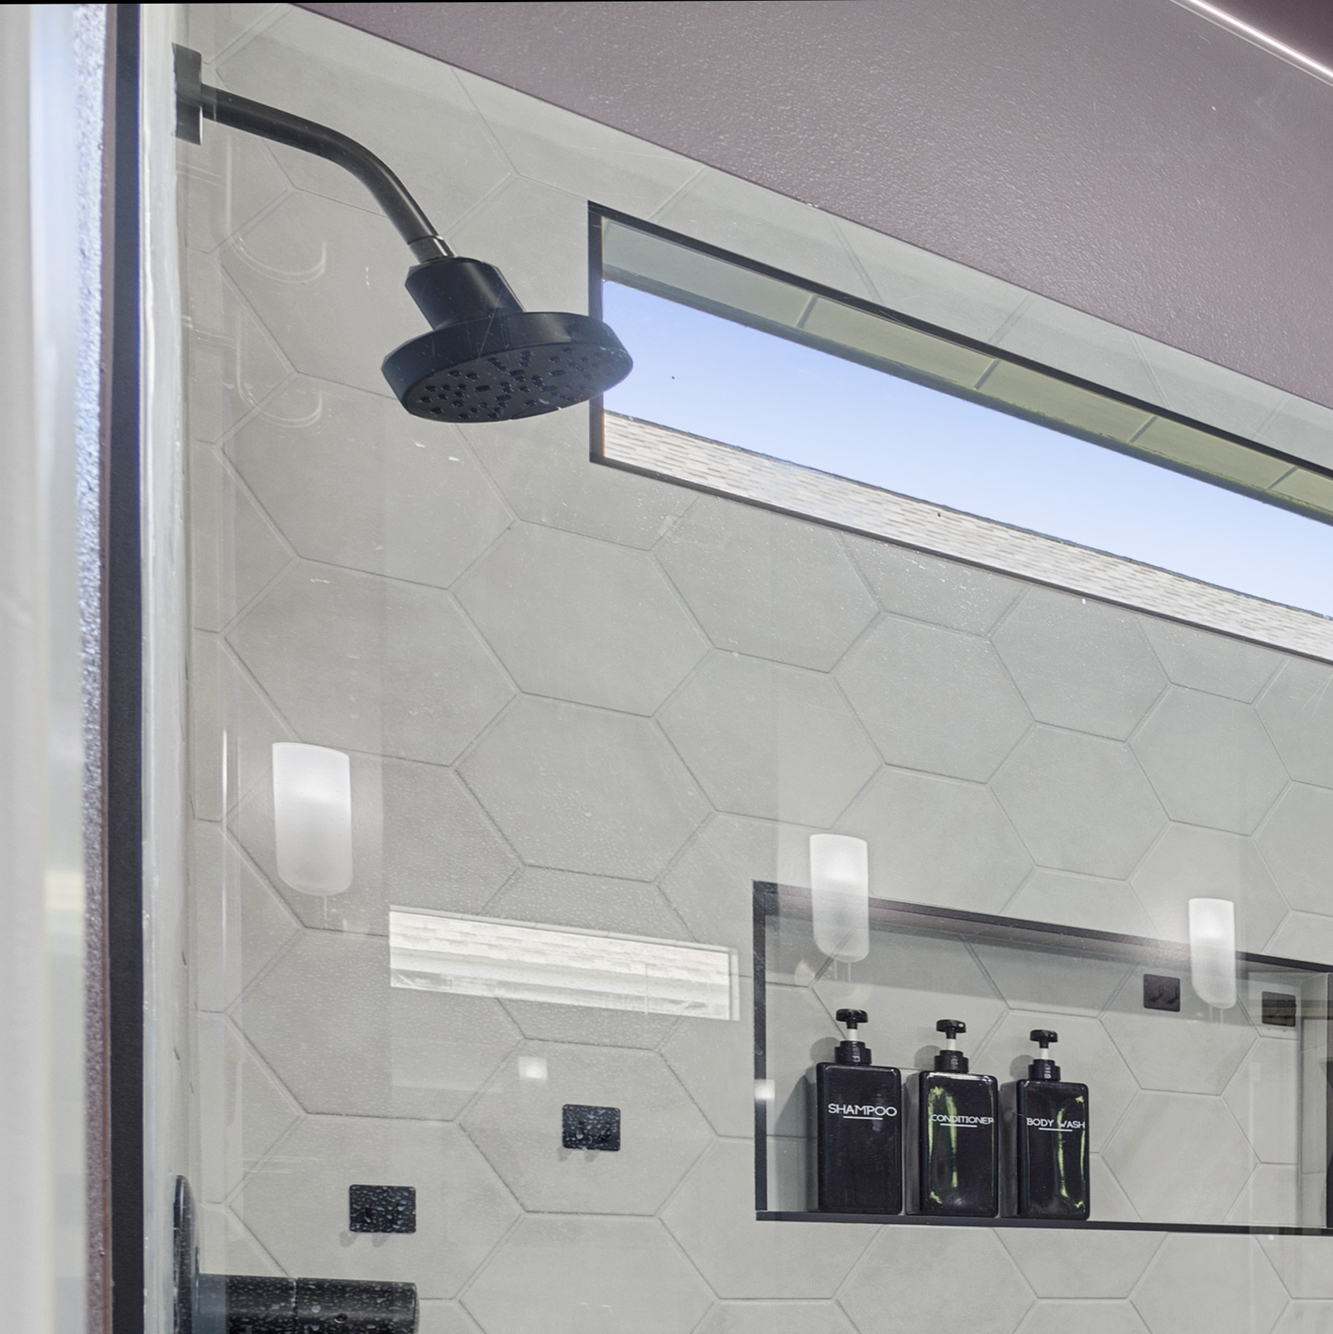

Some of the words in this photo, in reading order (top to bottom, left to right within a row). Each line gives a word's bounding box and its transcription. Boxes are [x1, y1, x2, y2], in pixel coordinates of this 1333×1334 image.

[828, 1103, 898, 1117] SHAMPOO
[1026, 1117, 1054, 1127] BODY
[1057, 1120, 1086, 1129] WASH
